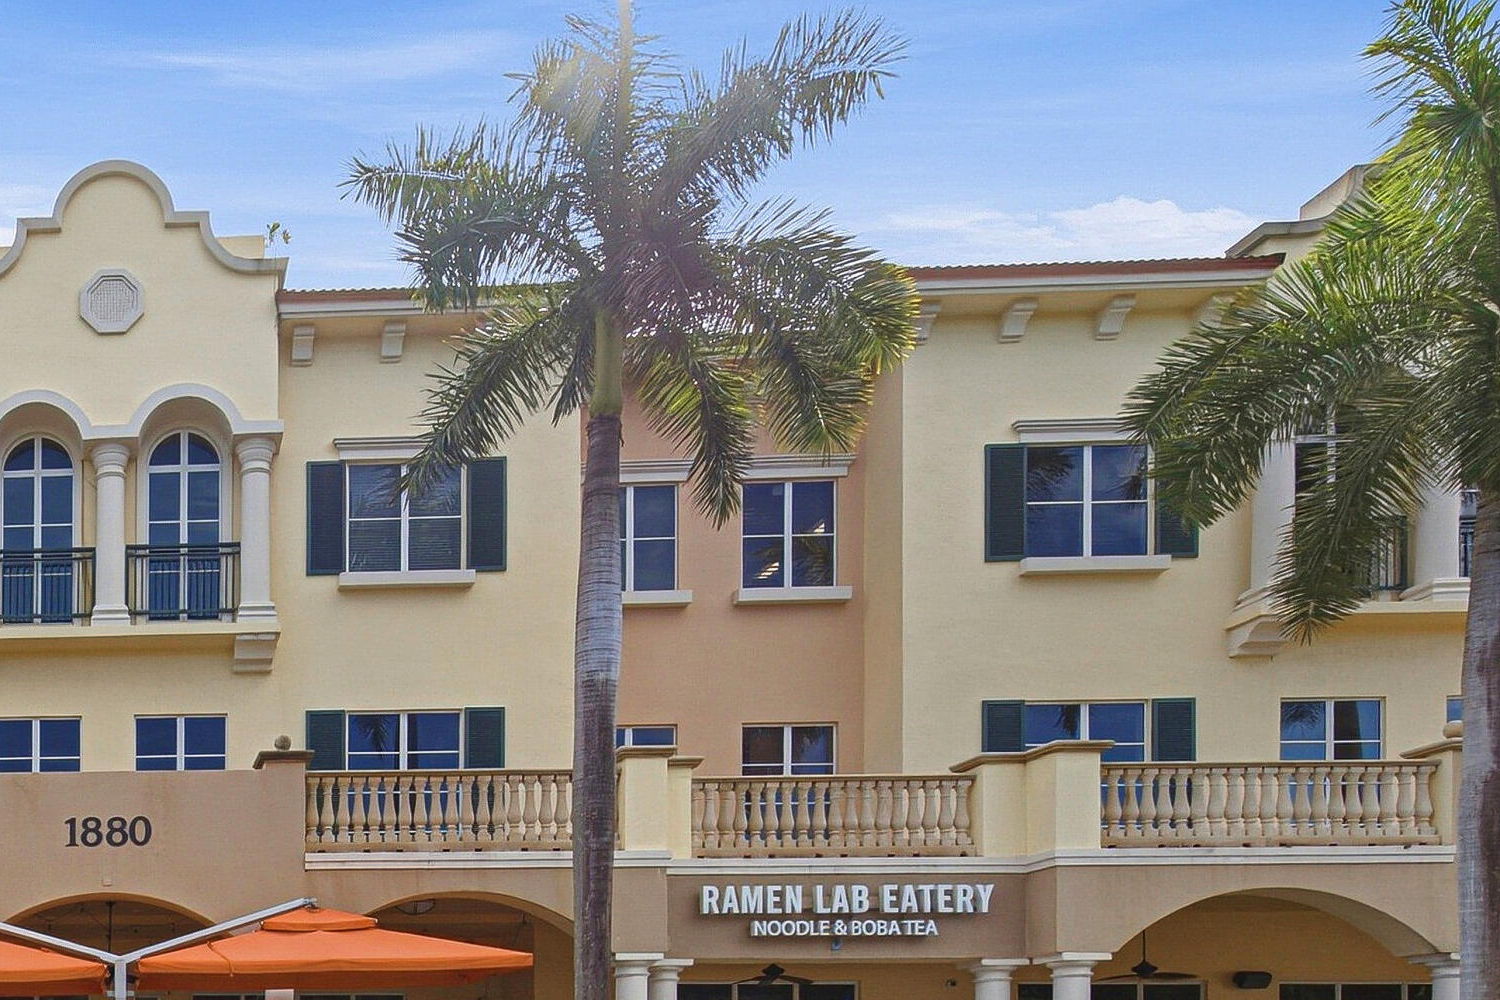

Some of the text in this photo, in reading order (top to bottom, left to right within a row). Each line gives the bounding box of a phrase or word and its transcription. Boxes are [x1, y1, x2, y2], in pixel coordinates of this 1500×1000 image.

[64, 815, 152, 847] 1880
[700, 884, 995, 915] RAMEN LAB EATERY
[752, 919, 939, 936] NOODLE & BOBA TEA
